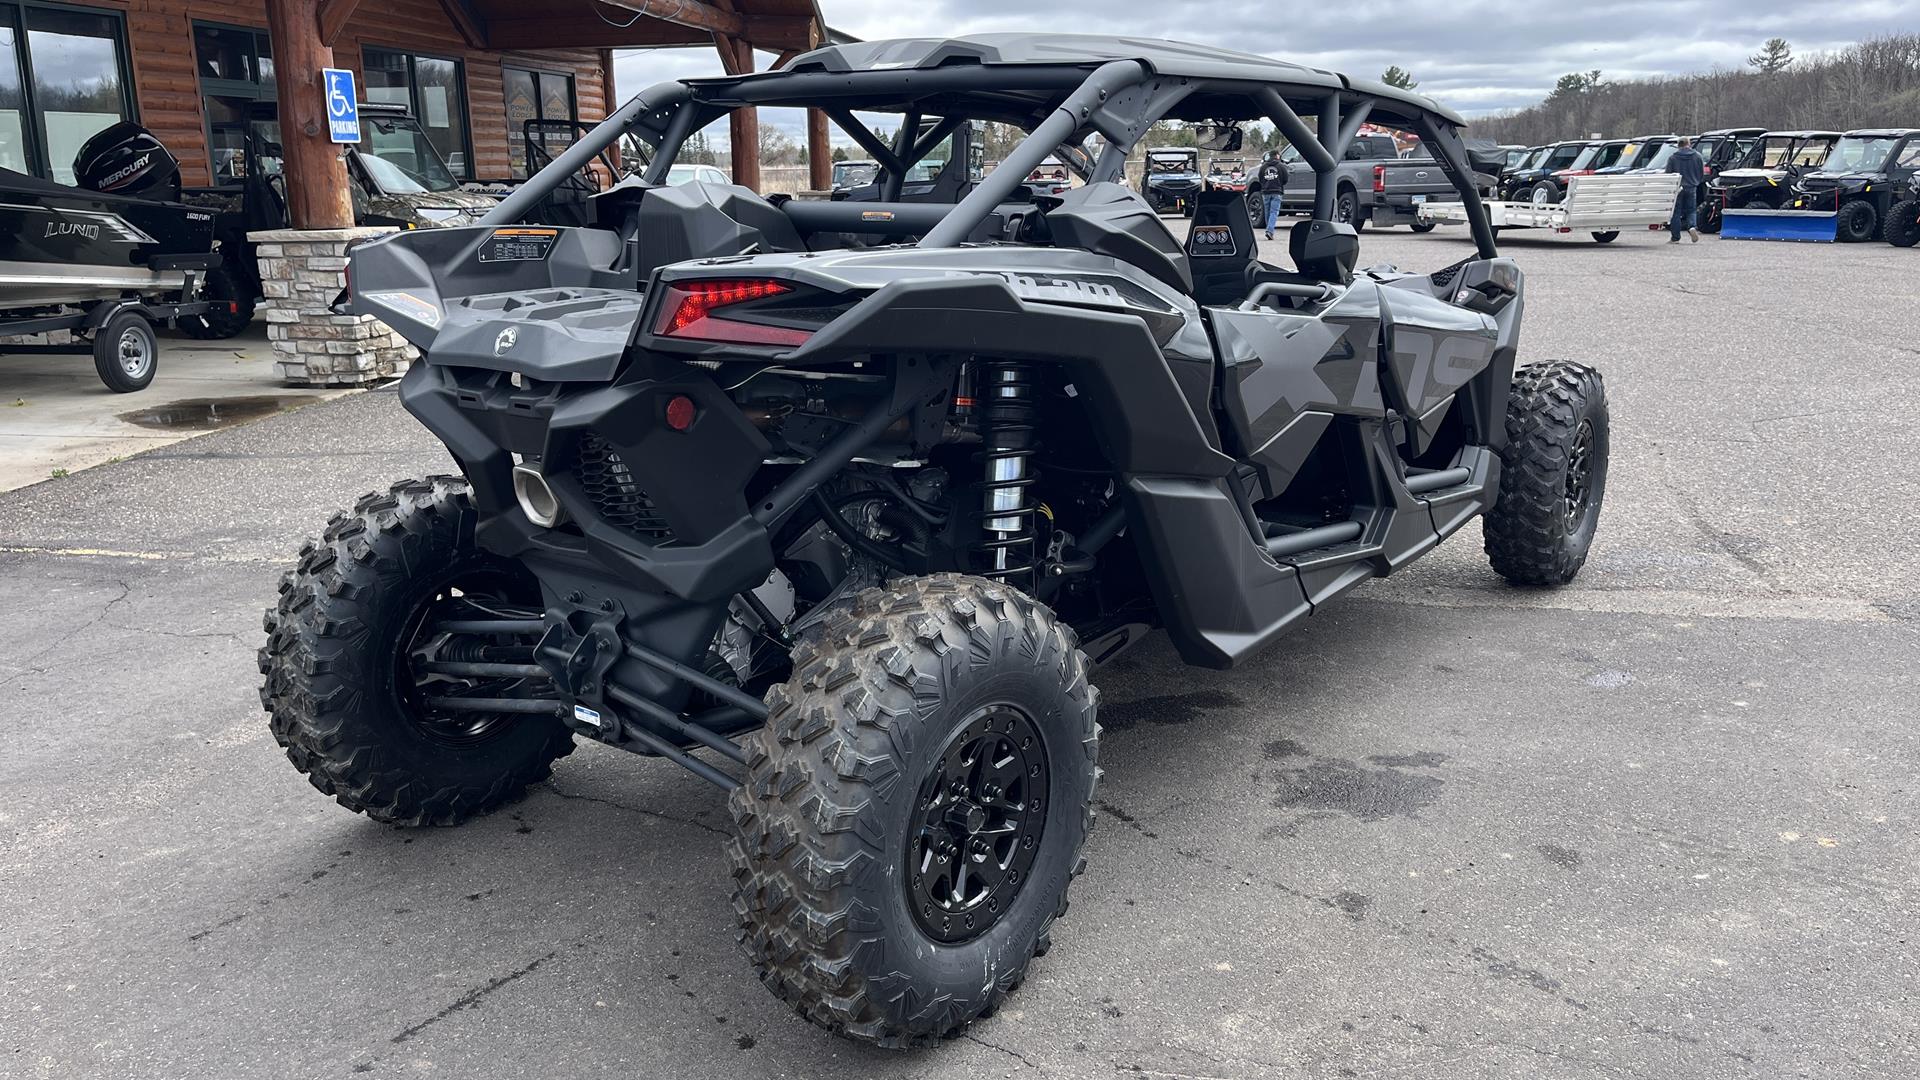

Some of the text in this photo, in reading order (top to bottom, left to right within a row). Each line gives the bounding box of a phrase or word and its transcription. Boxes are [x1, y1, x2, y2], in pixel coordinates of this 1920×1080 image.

[331, 121, 358, 135] PARKING
[98, 153, 151, 188] MERCURY
[44, 222, 100, 240] LUND
